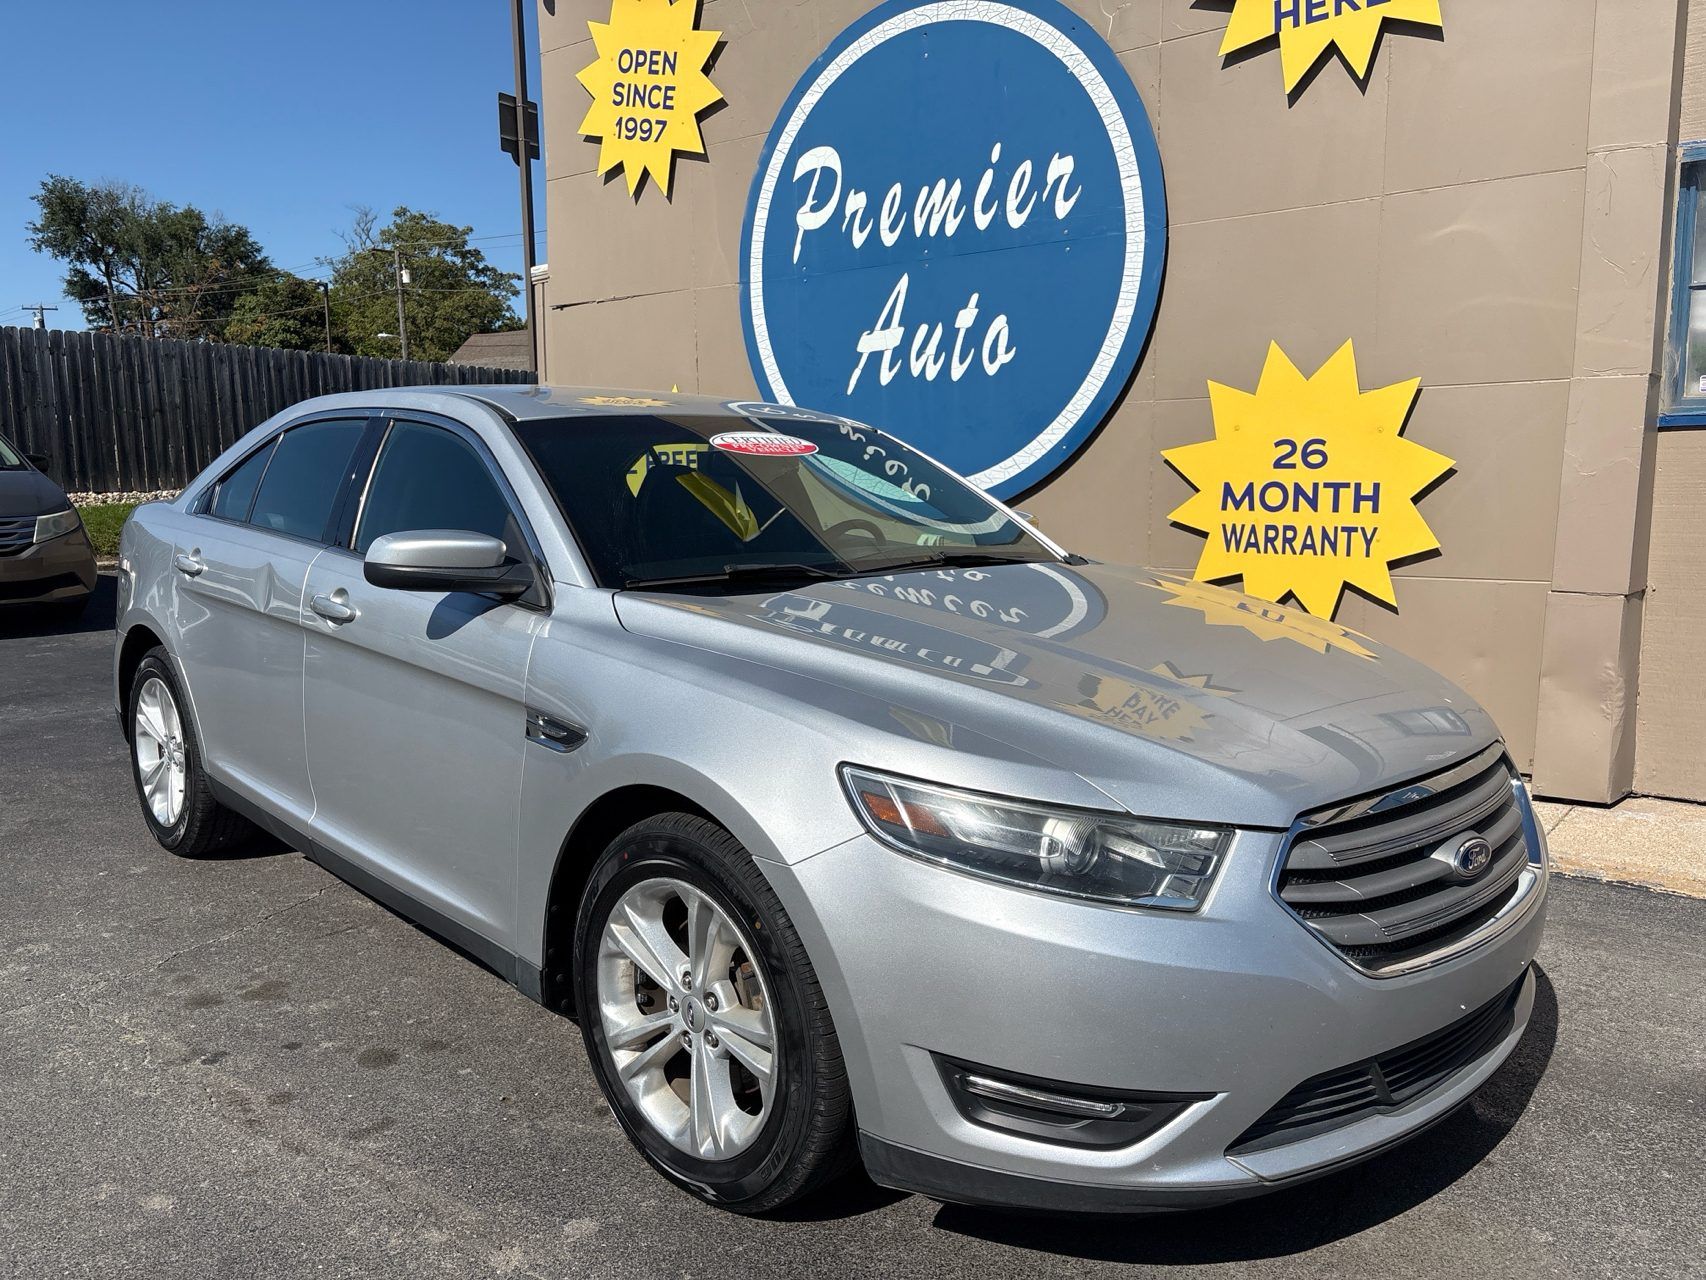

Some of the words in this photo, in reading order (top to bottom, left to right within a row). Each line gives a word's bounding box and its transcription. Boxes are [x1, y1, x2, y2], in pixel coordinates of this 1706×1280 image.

[618, 48, 677, 76] OPEN
[612, 82, 676, 110] SINCE
[615, 116, 668, 143] 1997
[792, 142, 1082, 265] Premier
[846, 272, 1016, 396] Auto
[1272, 438, 1329, 469] 26
[1221, 481, 1381, 514] MONTH
[1221, 523, 1378, 558] WARRANTY
[1468, 846, 1488, 870] Ford
